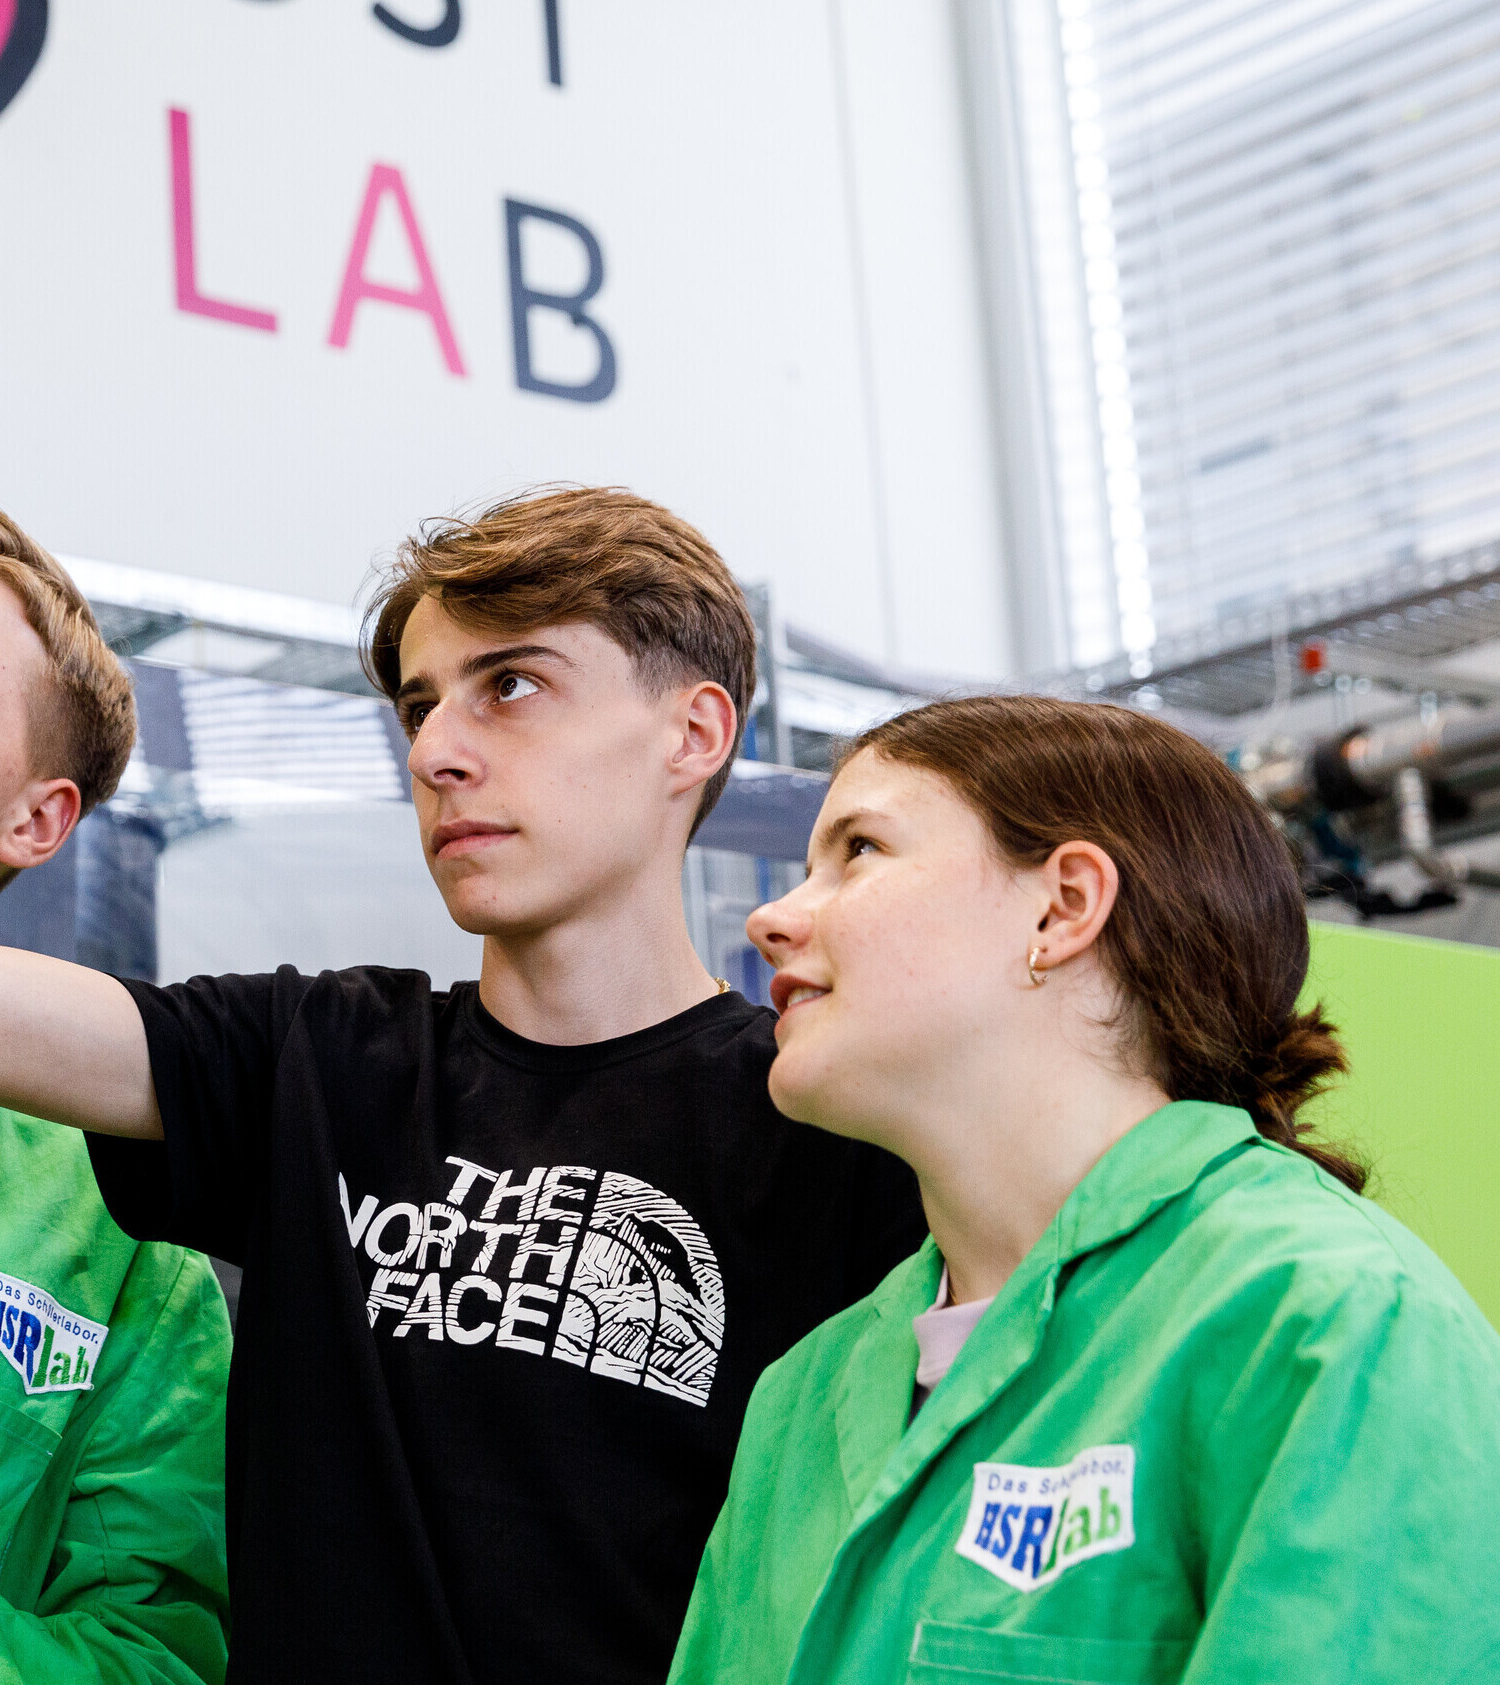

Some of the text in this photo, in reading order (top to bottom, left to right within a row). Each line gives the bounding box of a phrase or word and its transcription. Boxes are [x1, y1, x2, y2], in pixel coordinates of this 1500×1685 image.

[168, 106, 618, 405] LAB
[338, 1171, 579, 1286] NORTH
[445, 1156, 597, 1222] THE
[366, 1268, 560, 1356] FACE
[988, 1473, 1027, 1493] Das
